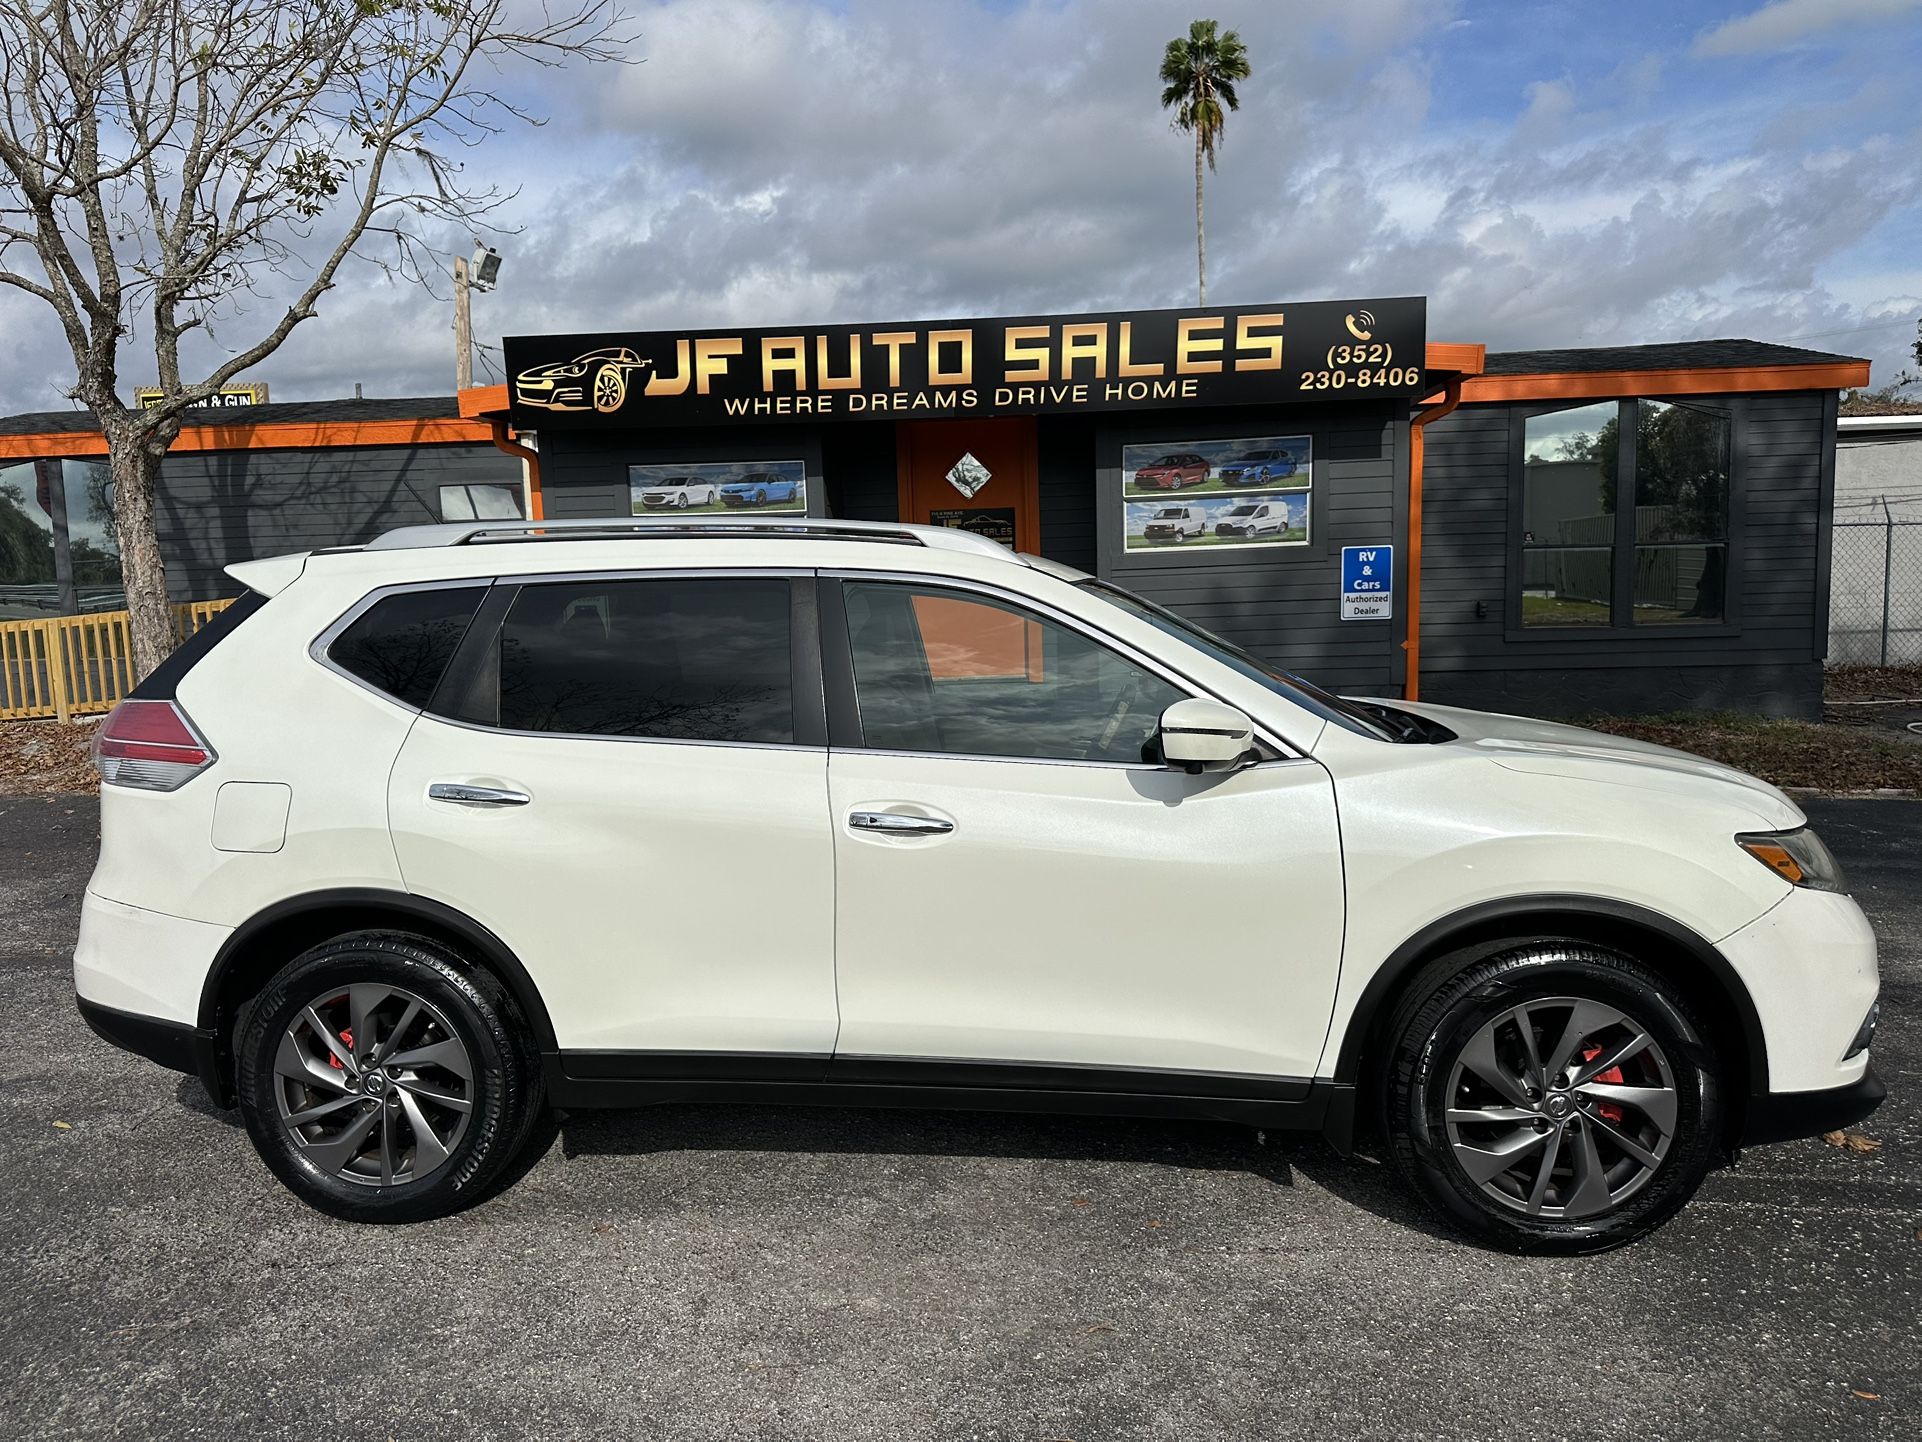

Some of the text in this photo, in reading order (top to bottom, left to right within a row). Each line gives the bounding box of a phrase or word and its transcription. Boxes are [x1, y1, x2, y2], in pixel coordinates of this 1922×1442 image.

[644, 313, 1285, 397] JF AUTO SALES
[1326, 342, 1393, 368] (352)
[1299, 366, 1420, 391] 230-8406
[211, 395, 221, 407] &
[225, 394, 251, 407] GUN
[724, 379, 1199, 417] WHERE DREAMS DRIVE HOME
[1359, 551, 1377, 562] RV
[1362, 565, 1373, 576] &
[1353, 579, 1381, 590] Cars
[1345, 595, 1389, 604] Authorized
[1353, 606, 1380, 615] Dealer
